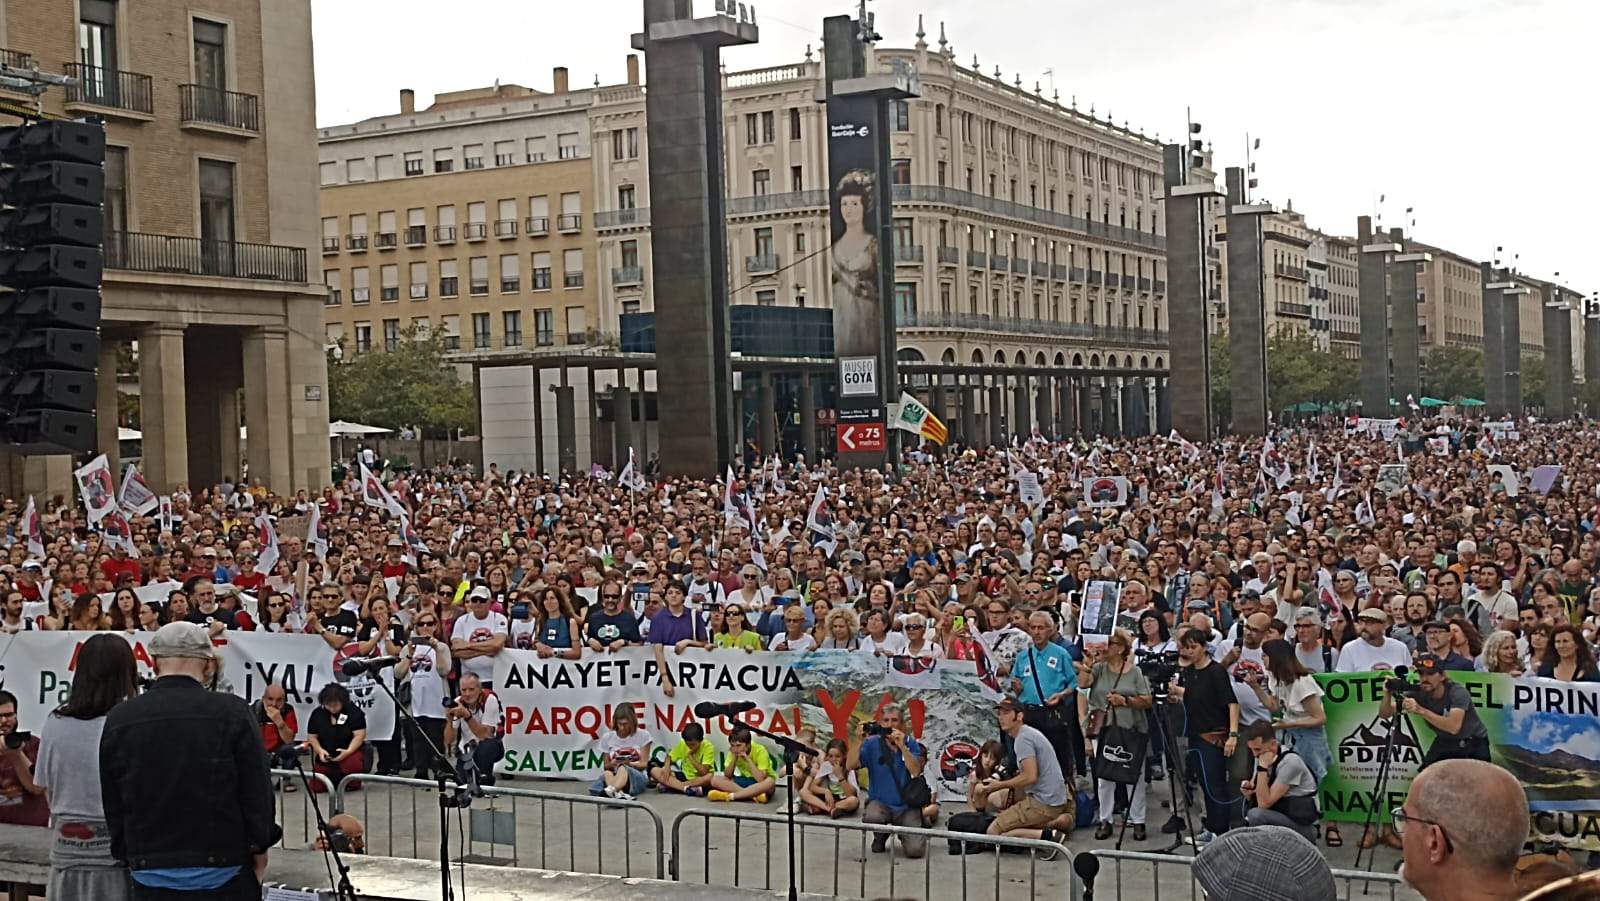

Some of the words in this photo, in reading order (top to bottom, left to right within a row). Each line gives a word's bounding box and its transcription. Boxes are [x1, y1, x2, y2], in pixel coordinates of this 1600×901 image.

[844, 361, 873, 373] MUSEO
[844, 372, 873, 384] GOYA
[865, 427, 880, 438] 75
[1513, 684, 1598, 717] PIRIN
[504, 748, 605, 773] SALVEM
